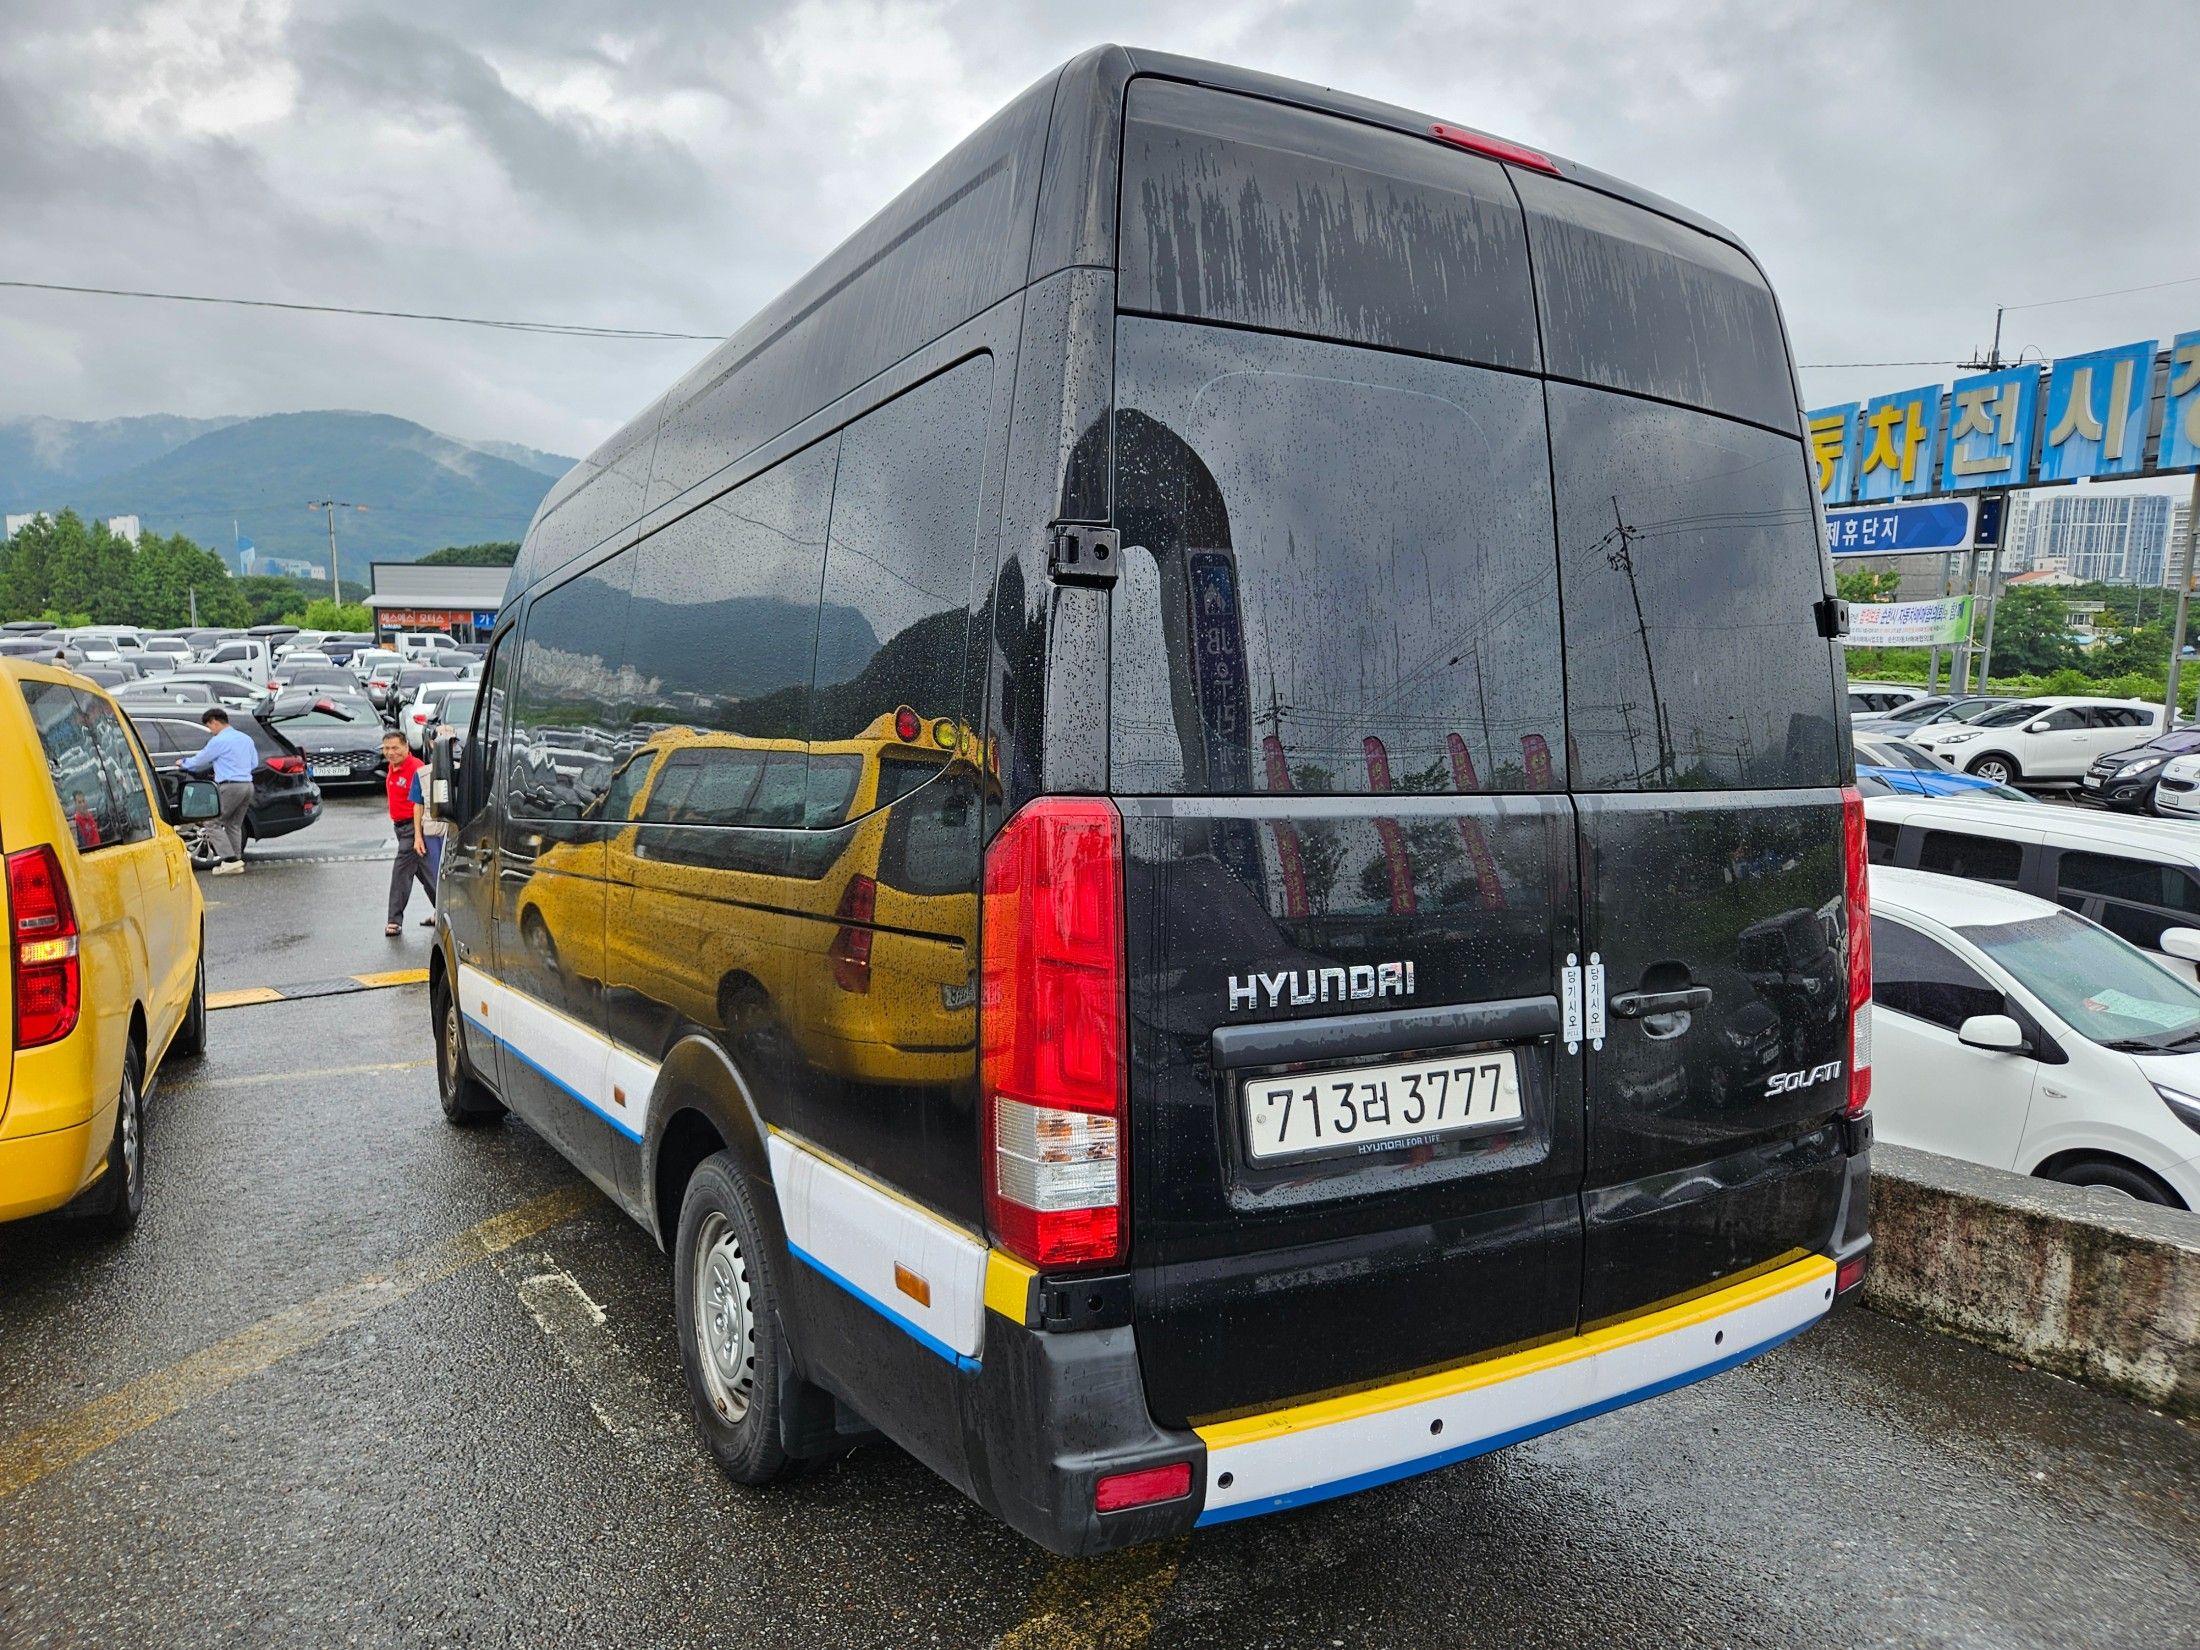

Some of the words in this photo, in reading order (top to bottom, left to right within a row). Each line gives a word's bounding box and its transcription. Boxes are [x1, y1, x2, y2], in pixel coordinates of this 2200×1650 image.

[1826, 515, 1899, 547] 제휴단지
[1228, 961, 1415, 1011] HYUNDAI
[1567, 970, 1577, 1027] 당기시오
[1590, 967, 1600, 1024] 당기시오
[1401, 1063, 1501, 1124] 3777
[1764, 1060, 1842, 1097] SOLATI
[1358, 1139, 1405, 1155] HYUNDAI
[1406, 1136, 1423, 1147] FOR
[1424, 1134, 1440, 1144] LIFE
